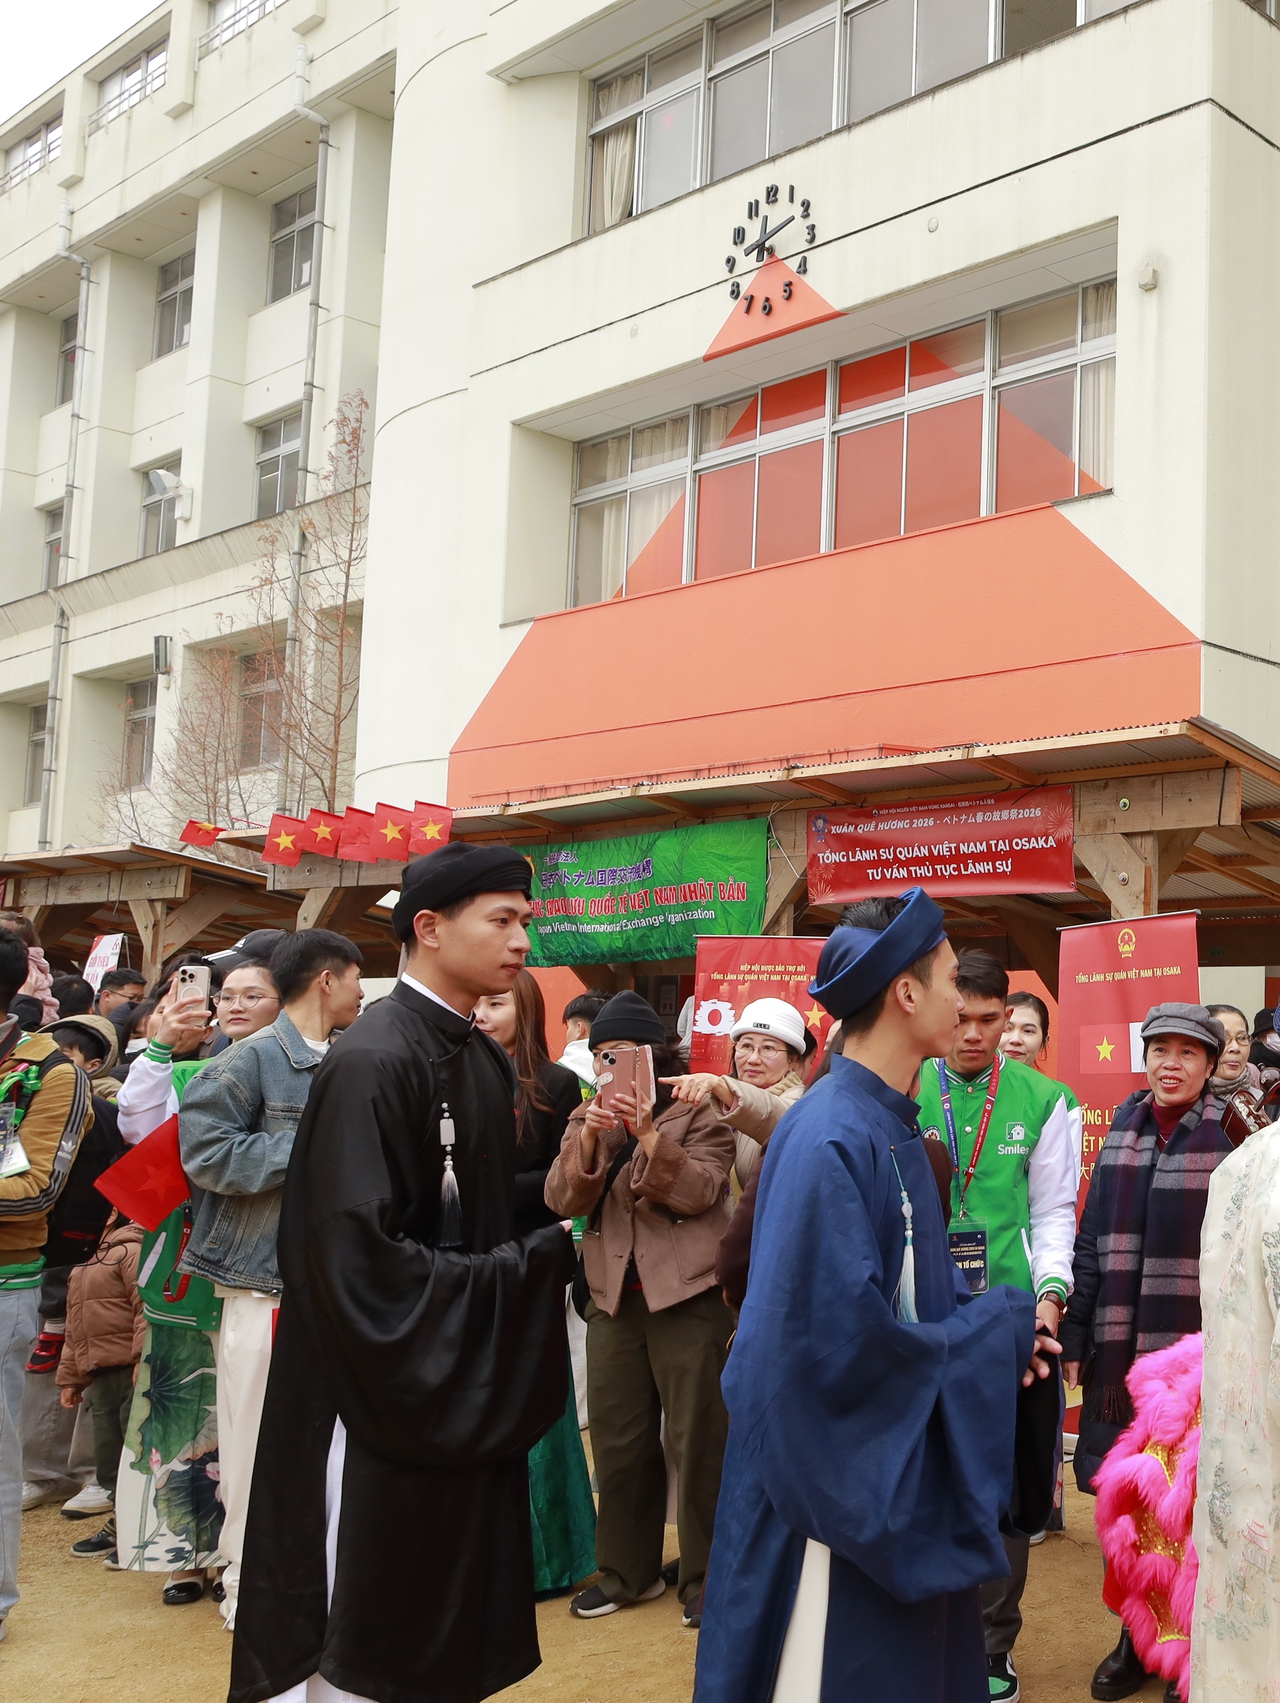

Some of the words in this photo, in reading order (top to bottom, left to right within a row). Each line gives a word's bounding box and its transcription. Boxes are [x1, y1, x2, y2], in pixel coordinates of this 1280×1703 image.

[765, 184, 779, 204] 12
[788, 184, 795, 204] 1
[747, 199, 759, 220] 11
[800, 198, 811, 219] 2
[732, 226, 746, 246] 10
[805, 223, 816, 244] 3
[725, 255, 736, 274] 9
[796, 255, 808, 274] 4
[729, 281, 741, 300] 8
[782, 280, 793, 301] 5
[743, 294, 754, 315] 7
[761, 296, 772, 316] 6
[830, 822, 855, 835] XUÂN
[857, 820, 875, 834] QUÊ
[877, 819, 910, 831] HƯƠNG
[912, 817, 934, 828] 2026
[848, 847, 878, 862] LÃNH
[880, 845, 894, 862] SỰ
[896, 843, 929, 860] QUÁN
[931, 840, 957, 859] VIỆT
[959, 841, 987, 854] NAM
[989, 839, 1010, 855] TẠI
[1012, 835, 1057, 850] OSAKA
[866, 866, 882, 881] TƯ
[883, 863, 908, 880] VẤN
[909, 861, 933, 878] THỦ
[934, 863, 959, 879] TỤC
[960, 859, 994, 875] LÃNH
[995, 857, 1012, 875] SỰ
[653, 885, 678, 907] NAM
[678, 877, 715, 905] NHẬT
[717, 875, 747, 902] BẢN
[621, 914, 665, 931] Exchange
[1127, 967, 1139, 981] VIỆT
[1140, 968, 1153, 978] NAM
[1162, 965, 1182, 976] OSAKA
[1081, 1102, 1102, 1126] ỔNG
[997, 1143, 1030, 1155] Smiles
[1083, 1131, 1096, 1157] ỆT
